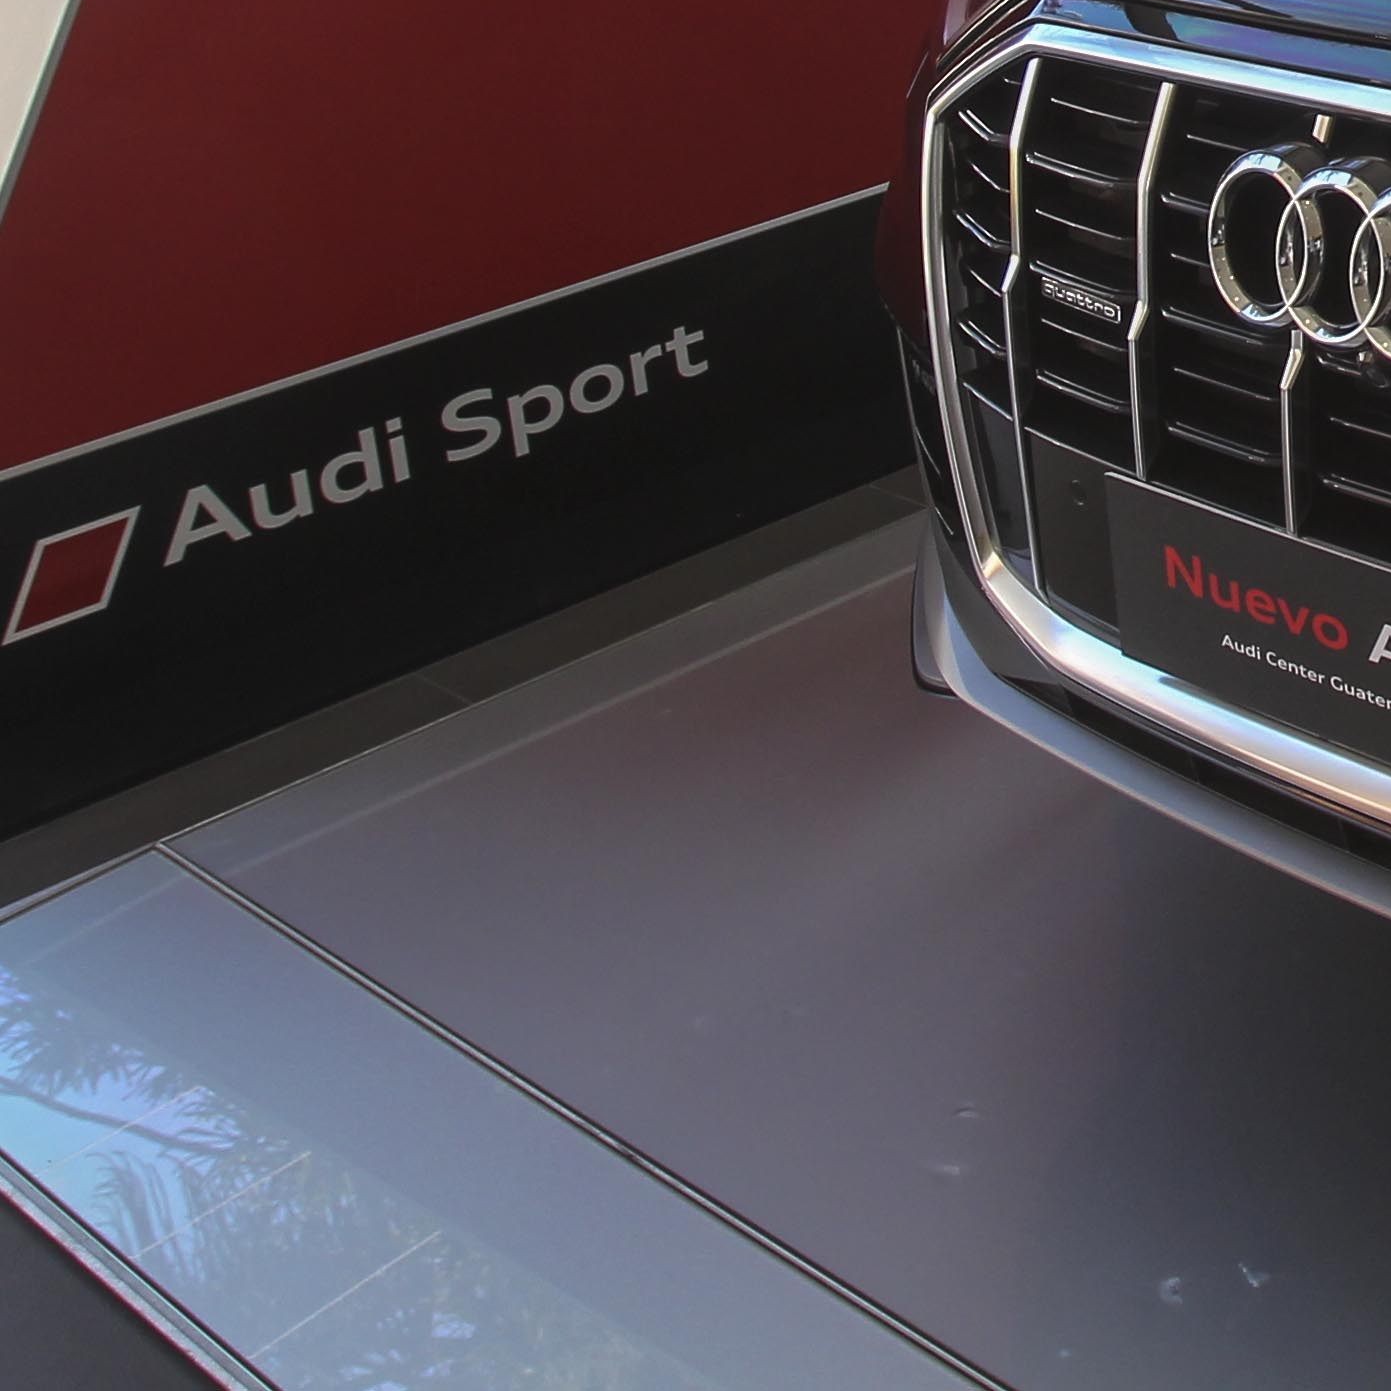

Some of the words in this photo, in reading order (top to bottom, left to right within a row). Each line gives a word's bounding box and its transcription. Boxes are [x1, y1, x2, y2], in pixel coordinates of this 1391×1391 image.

[1043, 283, 1116, 318] quattro
[163, 416, 411, 567] Audi
[441, 326, 709, 462] Sport
[1164, 544, 1349, 650] Nuevo
[1221, 634, 1261, 660] Audi
[1266, 651, 1325, 684] Center
